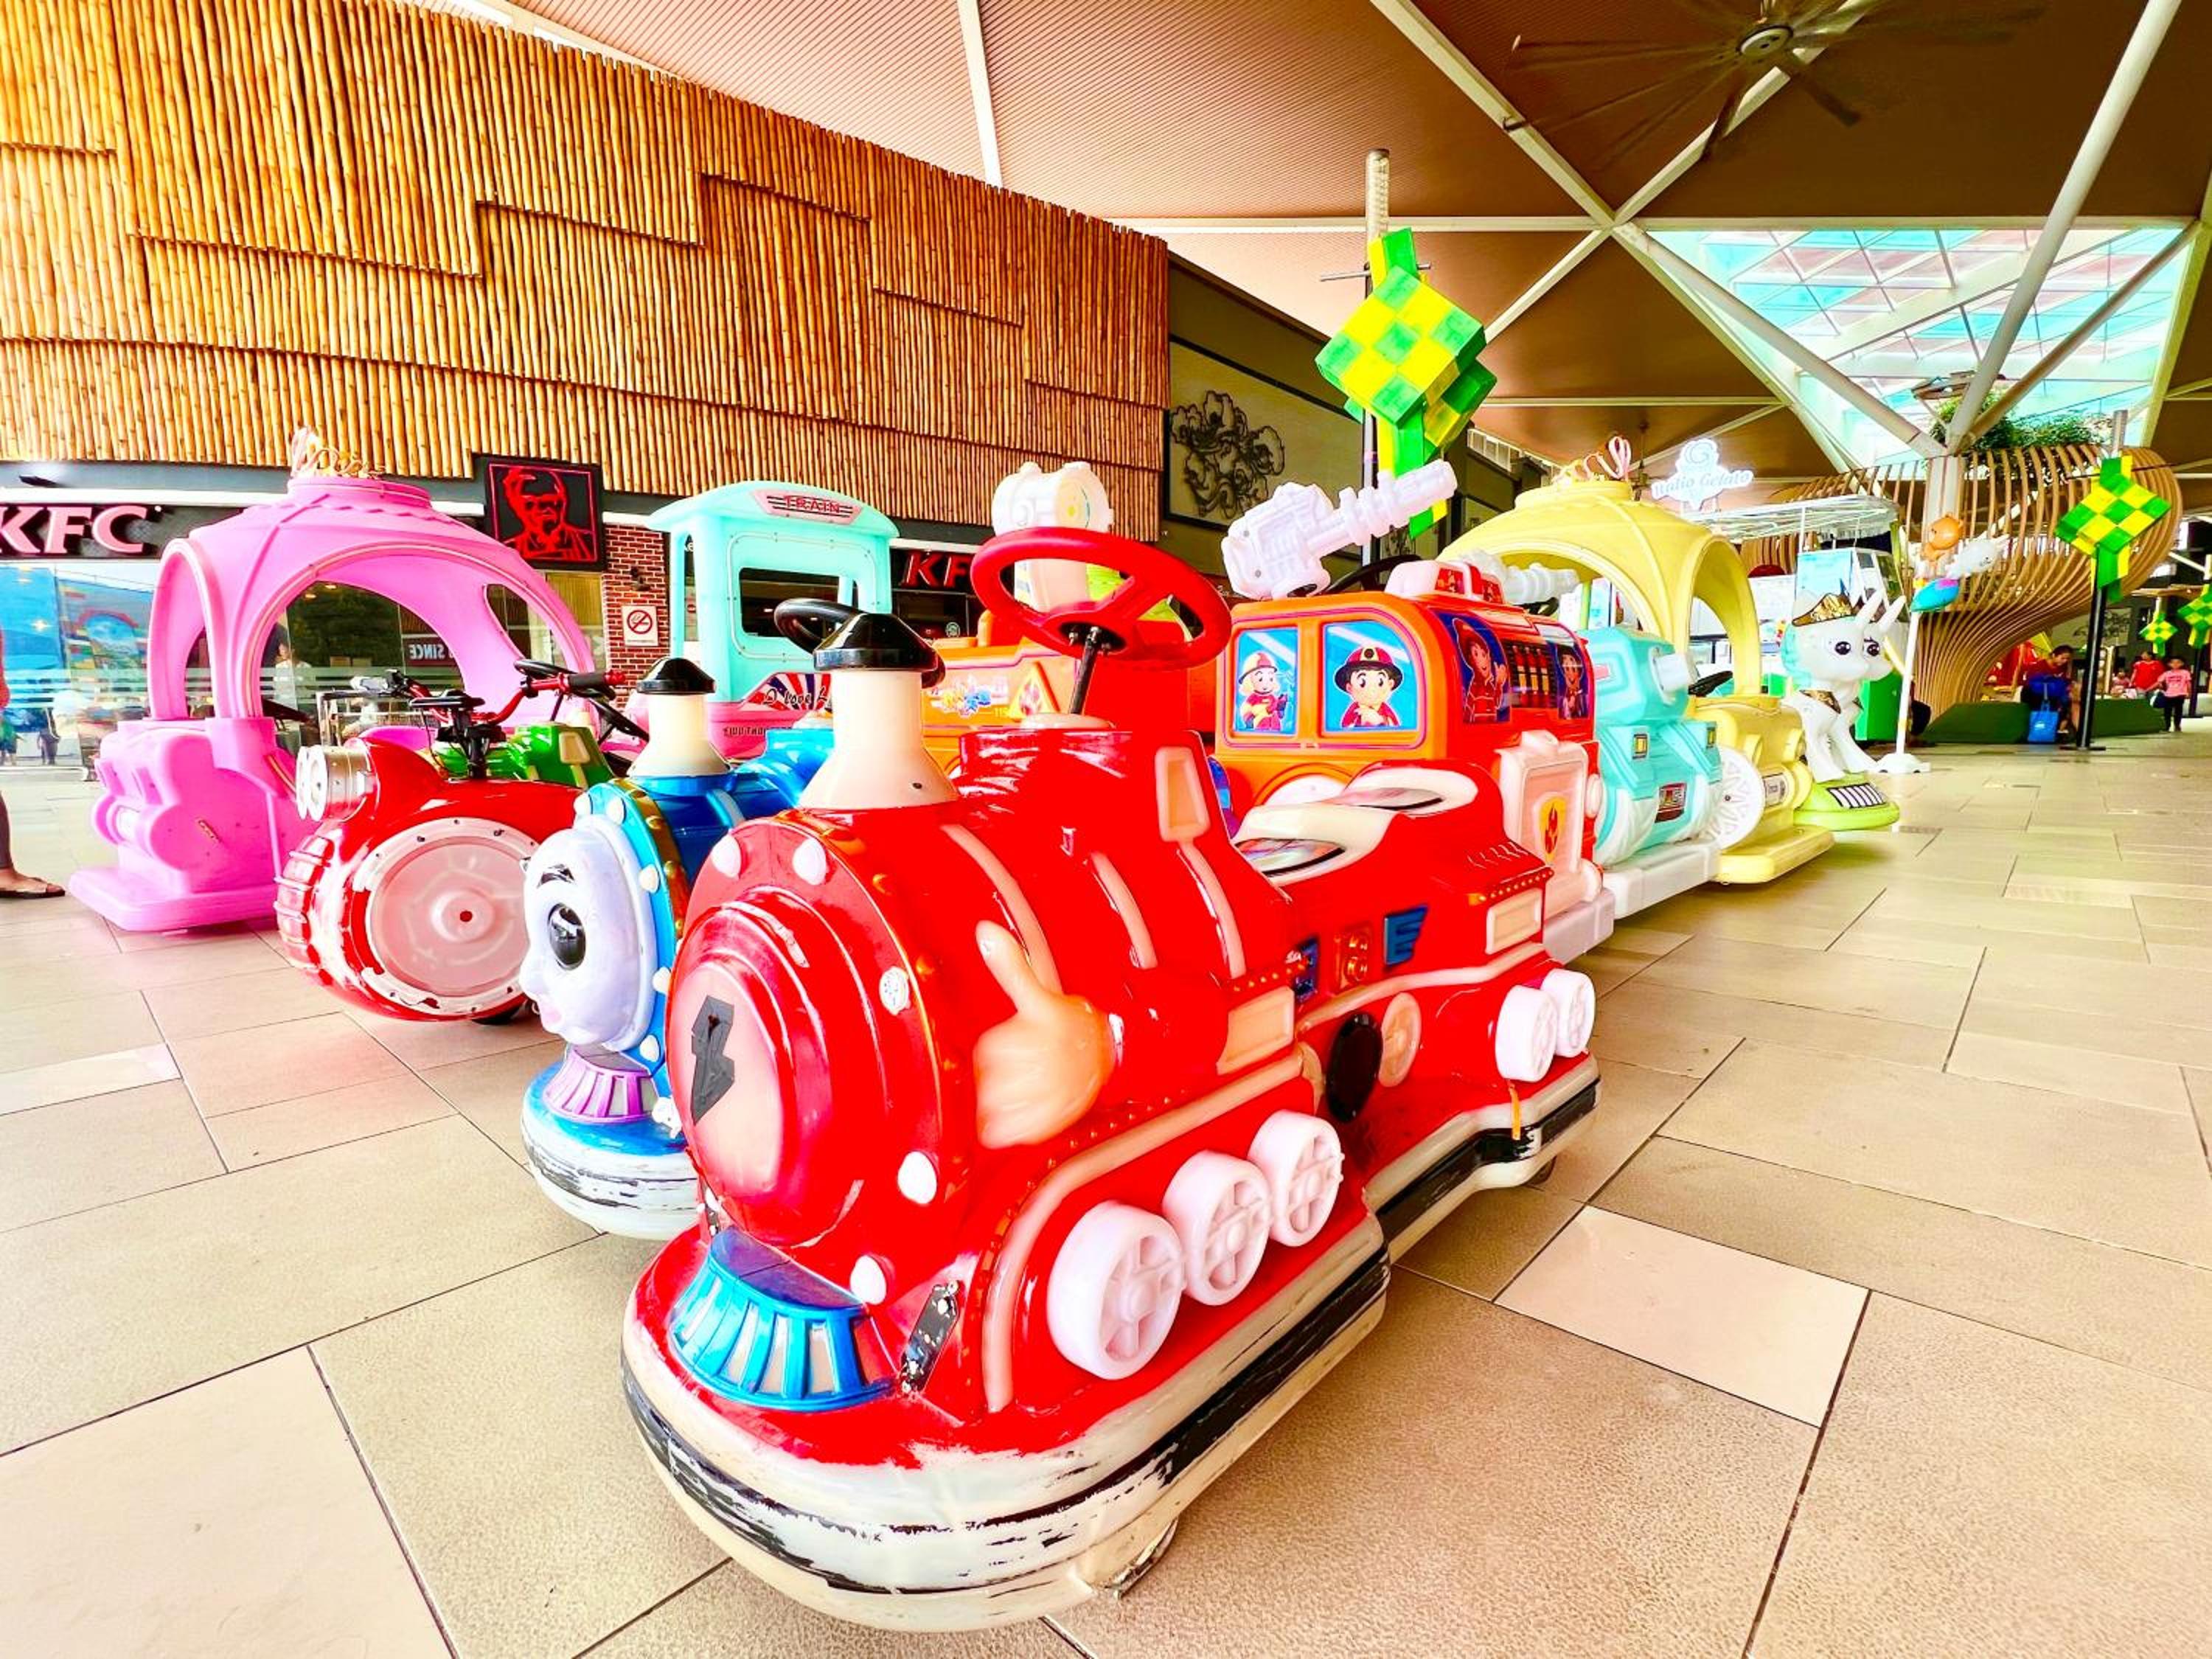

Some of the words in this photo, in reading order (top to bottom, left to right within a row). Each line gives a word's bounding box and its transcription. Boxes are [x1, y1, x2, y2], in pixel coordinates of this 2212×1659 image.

[1699, 473, 1750, 487] Gelato
[784, 495, 841, 513] TRAIN
[0, 505, 147, 554] KFC
[901, 552, 973, 588] KF
